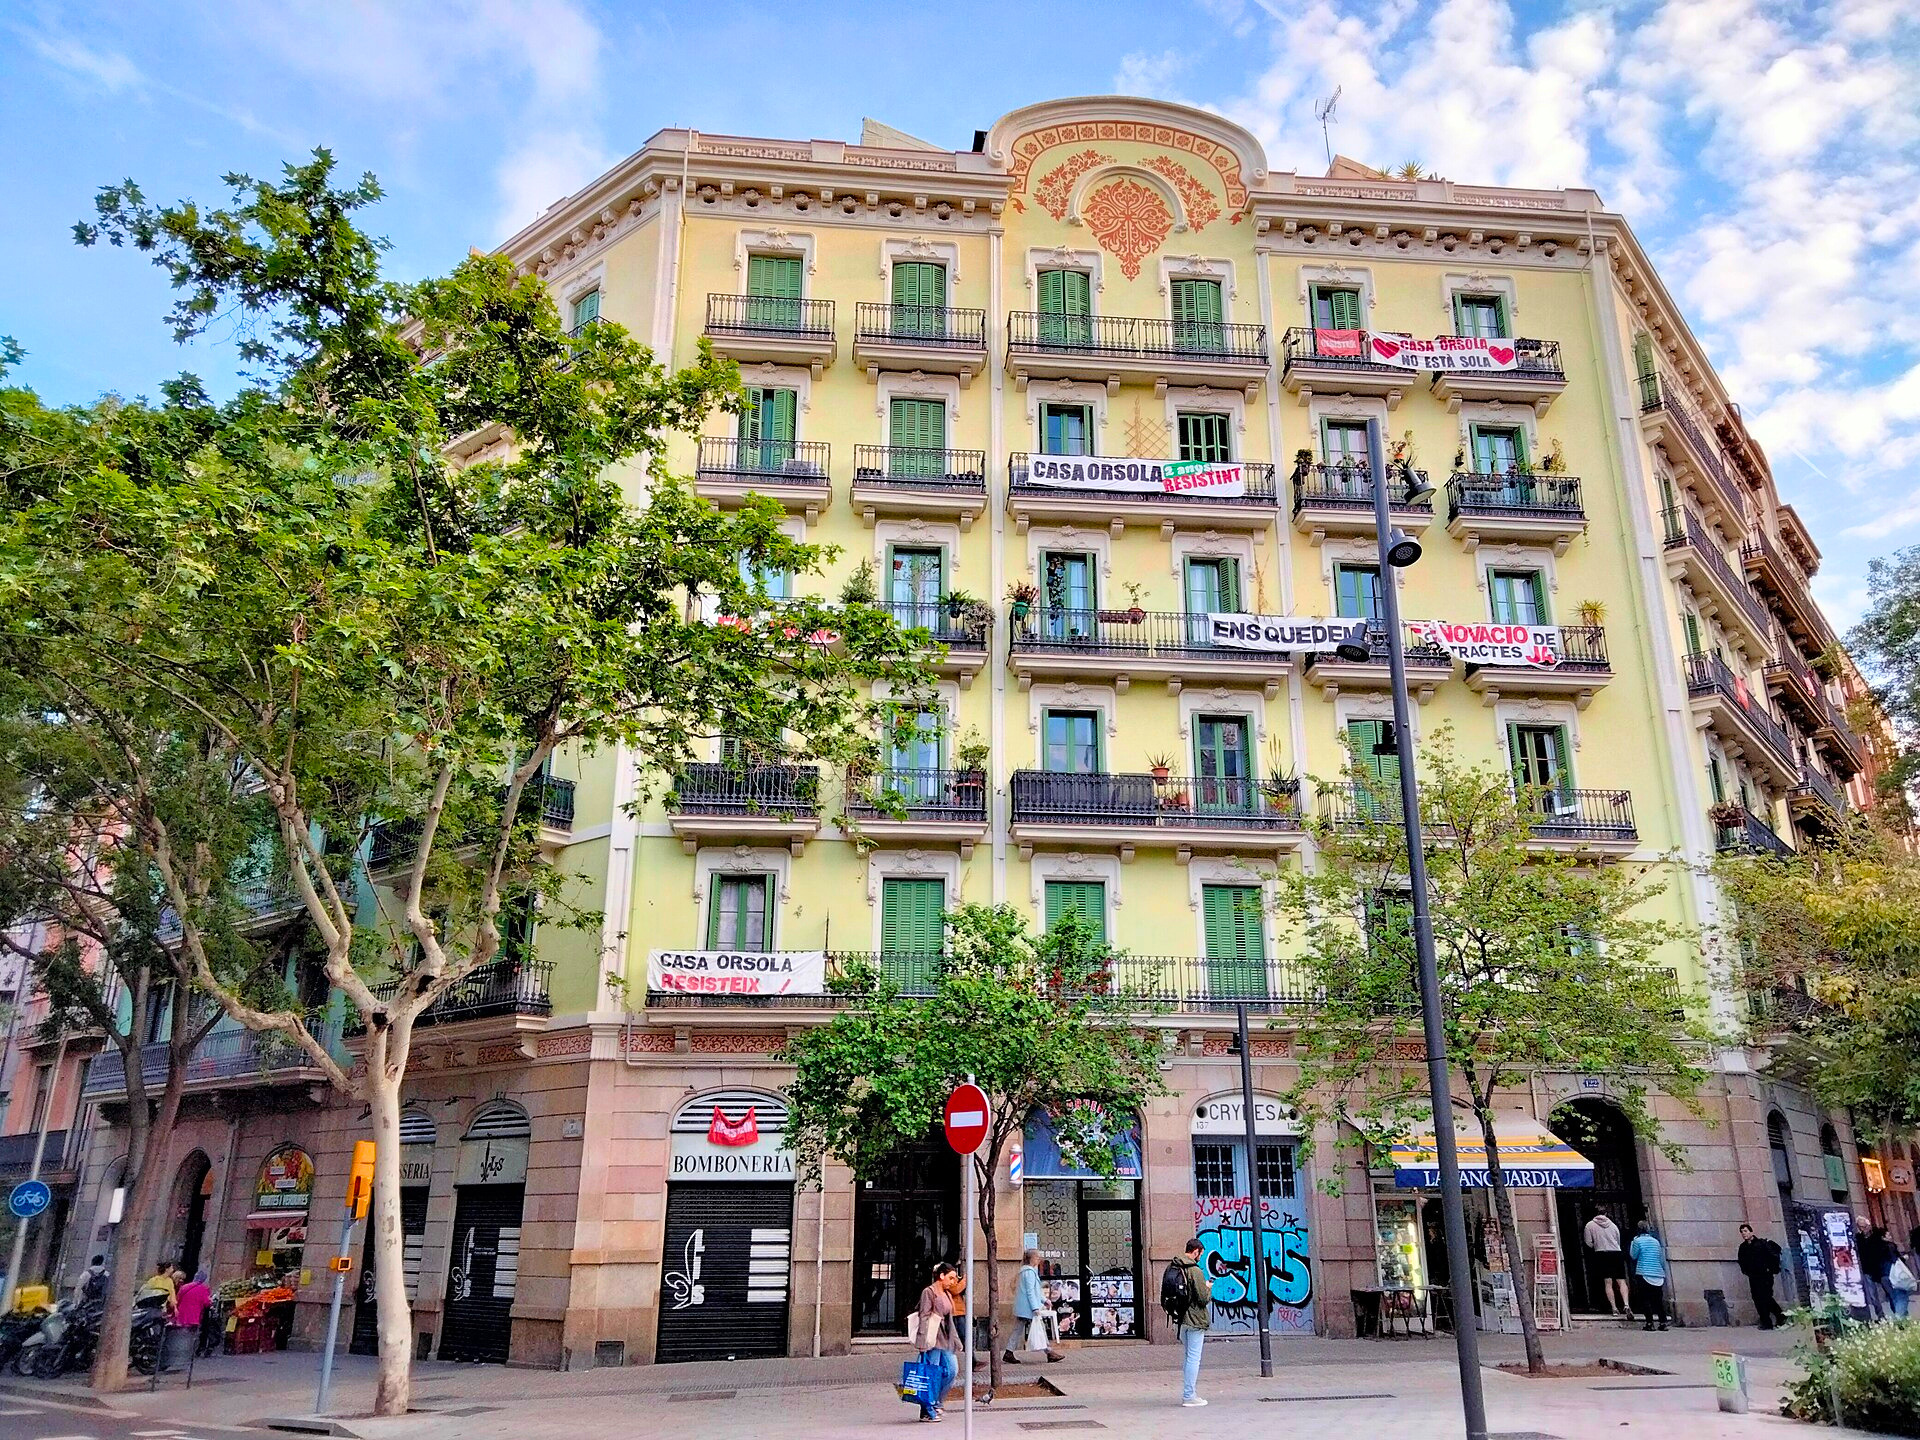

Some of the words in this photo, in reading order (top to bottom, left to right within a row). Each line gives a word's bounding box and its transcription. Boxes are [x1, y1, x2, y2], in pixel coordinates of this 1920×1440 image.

[1400, 340, 1435, 352] CASA
[1440, 337, 1488, 351] ORSOLA
[1401, 355, 1419, 367] NO
[1424, 354, 1456, 368] ESTÀ
[1460, 355, 1491, 368] SOLA
[1034, 460, 1085, 481] CASA
[1087, 463, 1163, 483] ORSOLA
[1163, 467, 1241, 493] RESISTINT
[1164, 466, 1174, 477] 2
[1213, 621, 1261, 641] ENS
[1438, 624, 1529, 645] NOVACIO
[1533, 633, 1556, 645] DE
[1450, 645, 1523, 659] TRACTES
[660, 953, 709, 970] CASA
[716, 954, 793, 972] ORSOLA
[660, 973, 760, 993] RESISTEIX
[1209, 1104, 1287, 1121] CRYESA
[674, 1155, 792, 1174] BOMBONERIA
